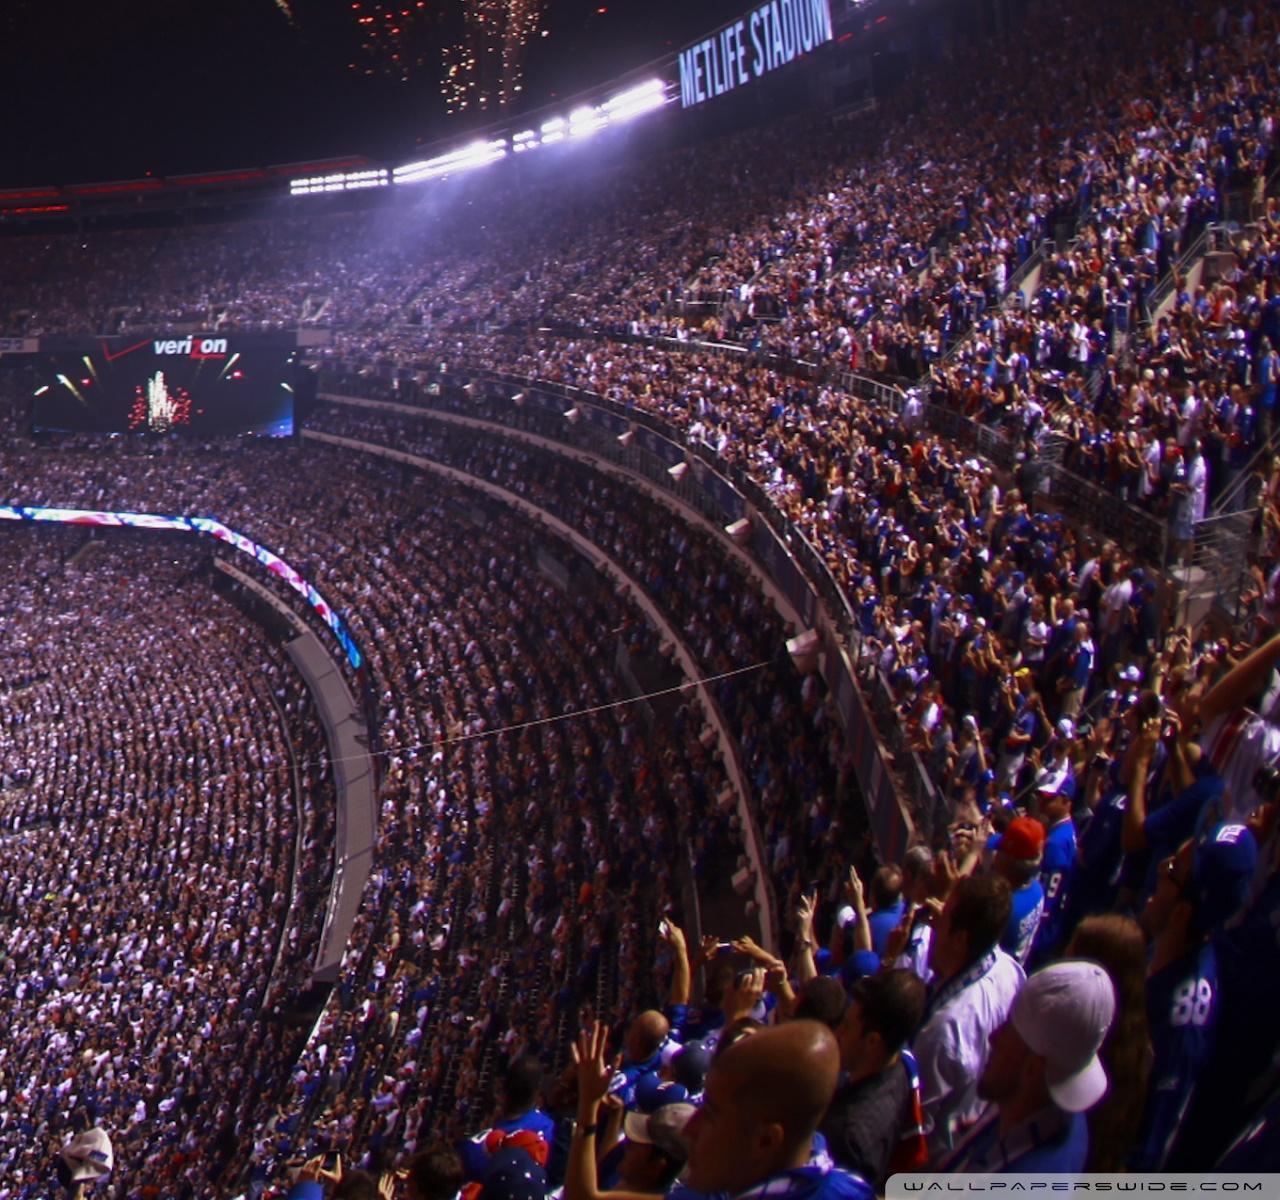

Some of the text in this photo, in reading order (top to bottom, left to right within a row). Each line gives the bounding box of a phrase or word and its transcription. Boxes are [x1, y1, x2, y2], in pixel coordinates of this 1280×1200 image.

[679, 20, 748, 109] METLIFE
[153, 336, 228, 357] verizon
[1171, 978, 1213, 1026] 88
